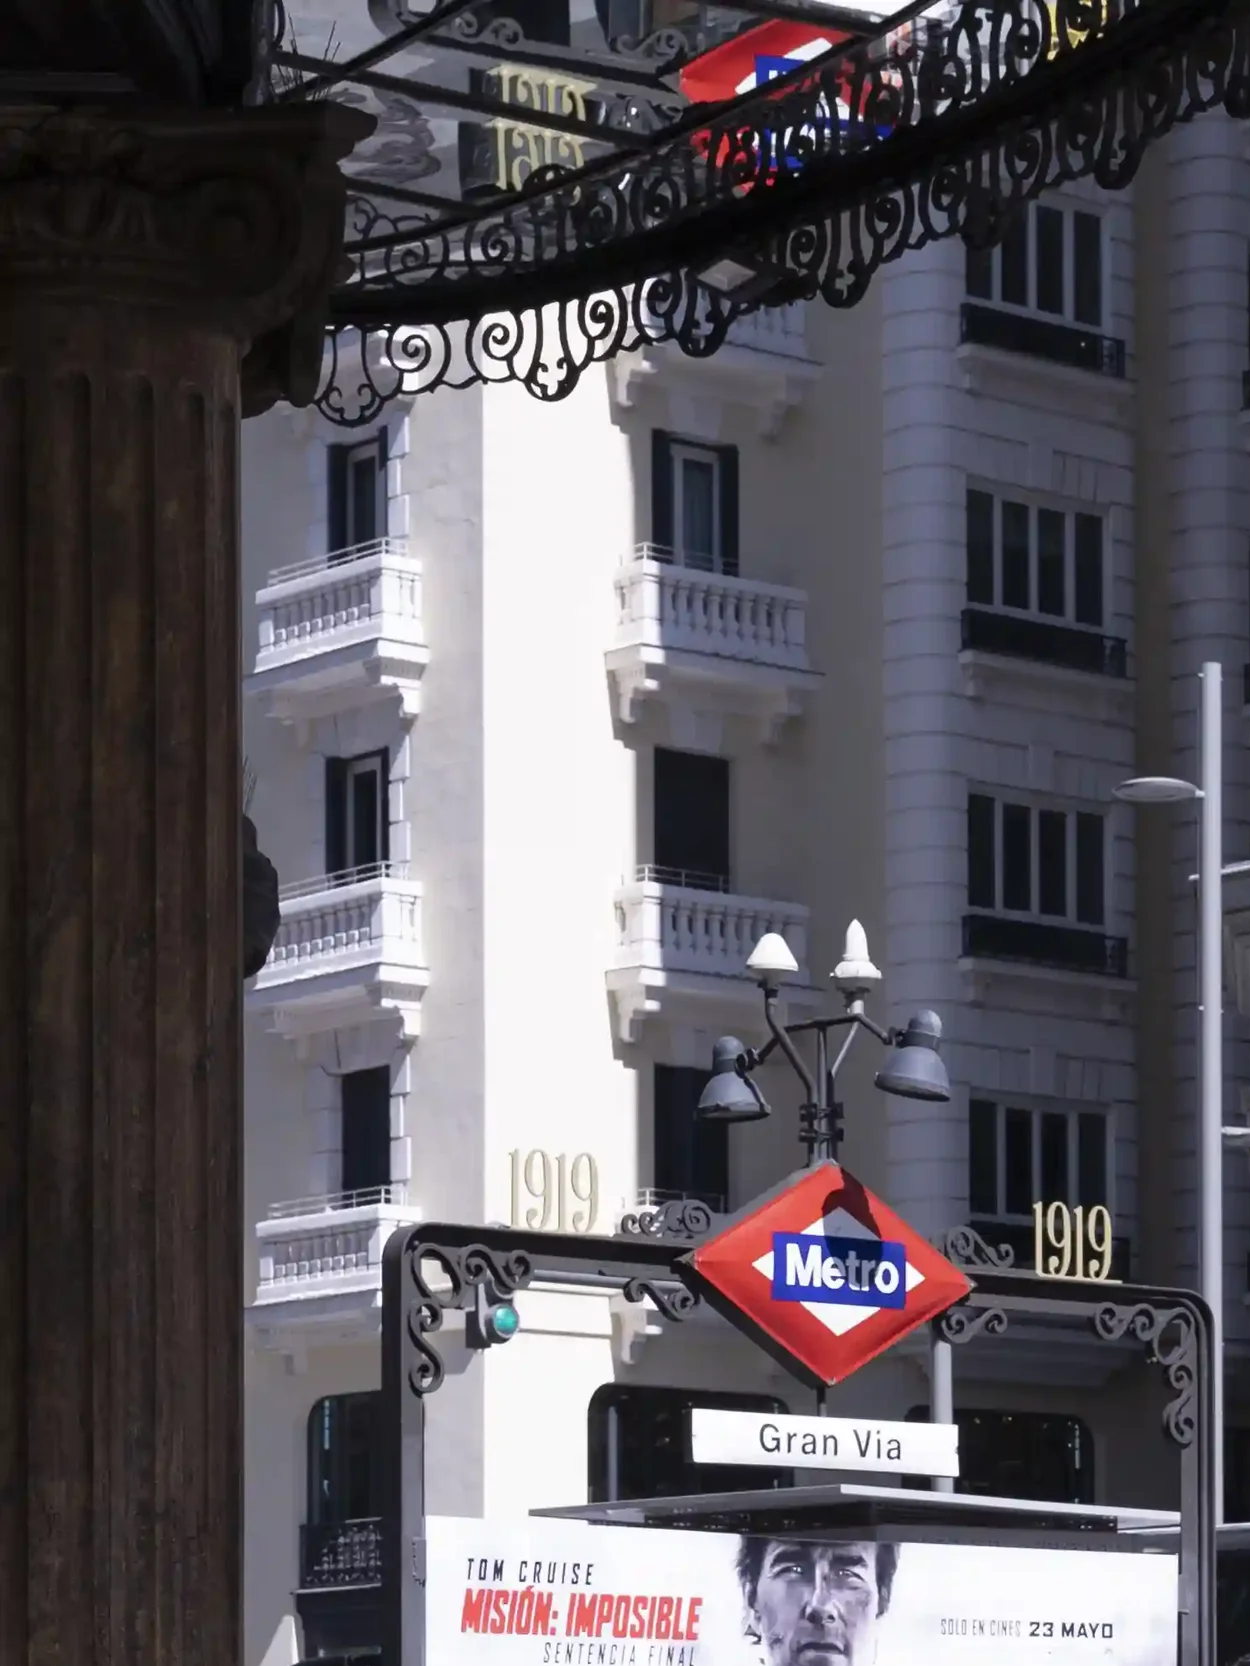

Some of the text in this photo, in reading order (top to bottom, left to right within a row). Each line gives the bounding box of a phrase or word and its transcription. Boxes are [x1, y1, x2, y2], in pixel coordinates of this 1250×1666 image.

[508, 1148, 600, 1233] 1919
[1033, 1201, 1112, 1280] 1919
[786, 1242, 900, 1294] Metro
[759, 1423, 902, 1460] Gran Via
[467, 1558, 594, 1585] TOM CRUISE
[461, 1585, 703, 1640] MISIÓN: IMPOSIBLE
[940, 1618, 1113, 1639] SOLO EN CINES 23 MAYO
[543, 1641, 636, 1665] SENTENCIA
